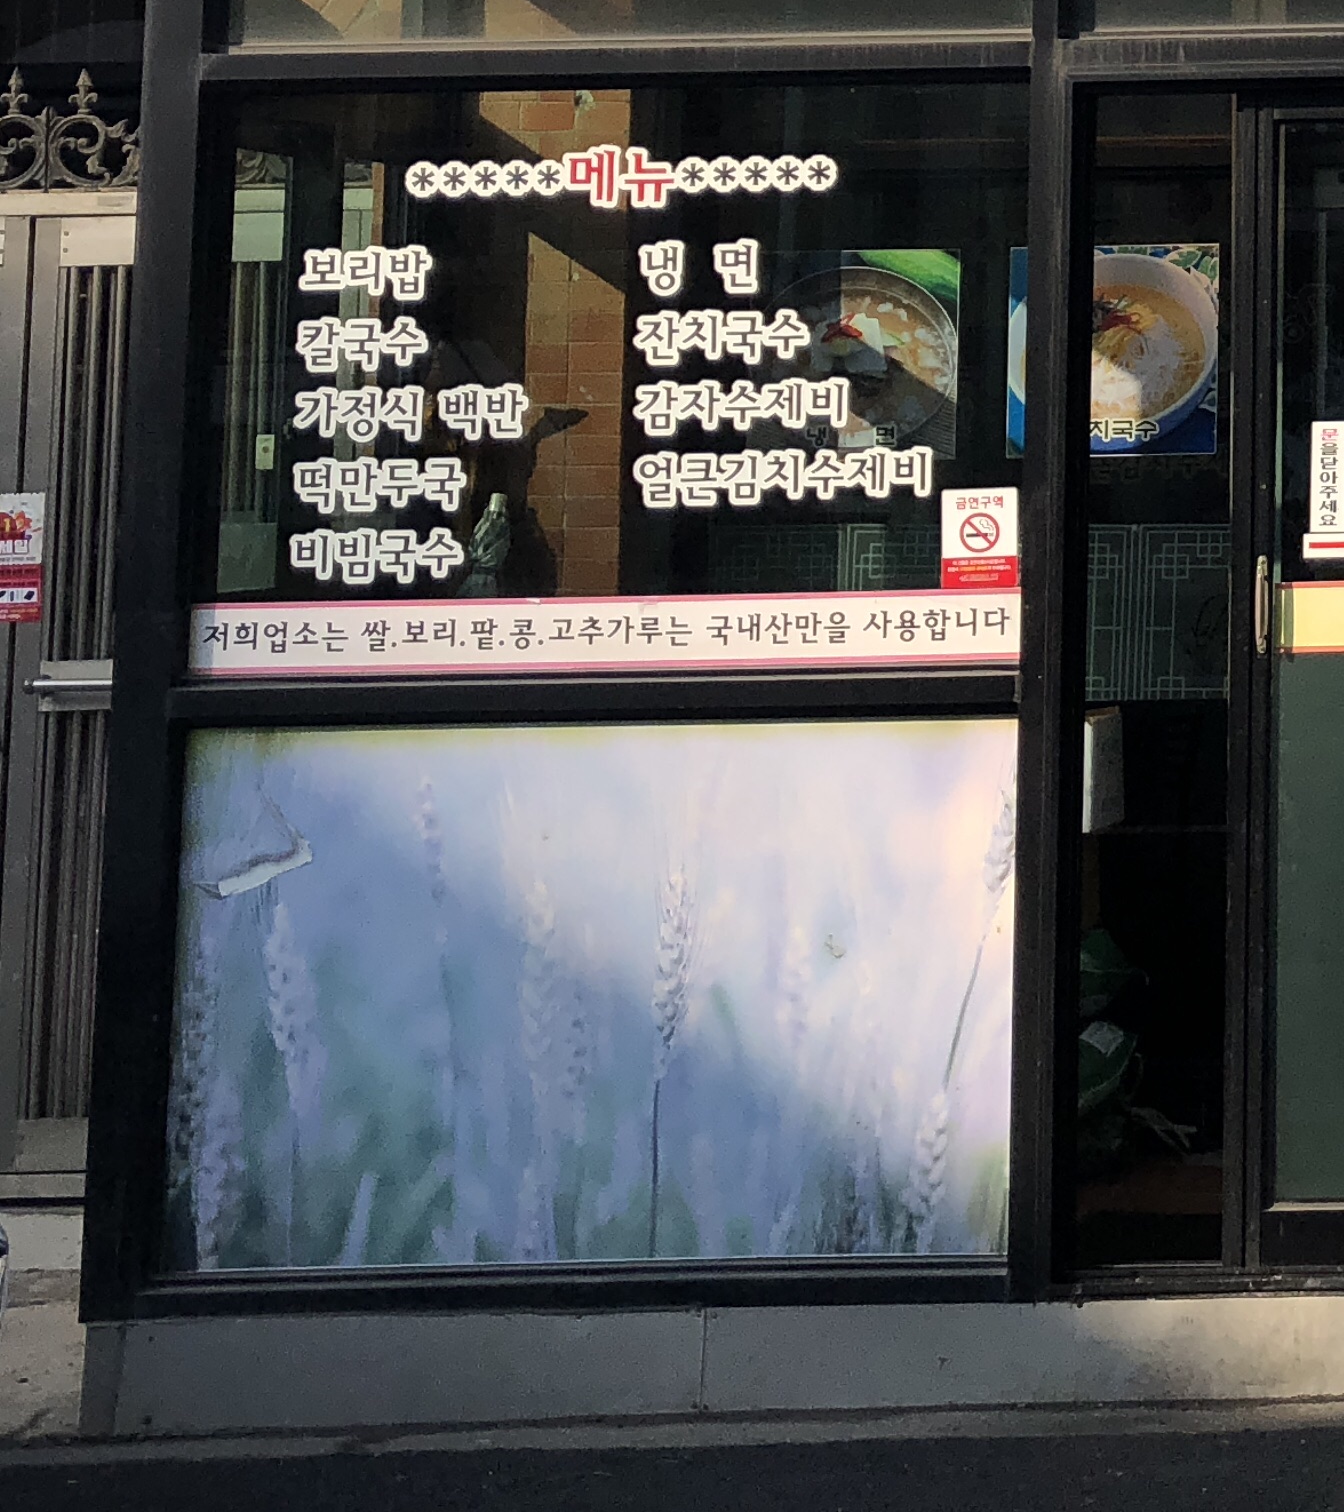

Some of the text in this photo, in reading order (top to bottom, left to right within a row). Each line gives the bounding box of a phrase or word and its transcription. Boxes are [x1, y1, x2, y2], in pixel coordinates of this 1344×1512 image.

[299, 246, 431, 299] 보리밥
[296, 318, 428, 371] 칼국수
[634, 310, 809, 364] 잔치국수
[293, 385, 528, 440] 가정식 백반
[634, 379, 848, 435] 감자수제비
[1090, 418, 1159, 441] 치국수
[293, 458, 467, 512] 떡만두국
[633, 449, 933, 507] 얼큰김치수제비
[956, 496, 1003, 510] 금연구역
[290, 530, 464, 583] 비빔국수
[203, 620, 349, 653] 저희업소는
[706, 611, 851, 645] 국내산만을
[863, 607, 1010, 643] 사용합니다
